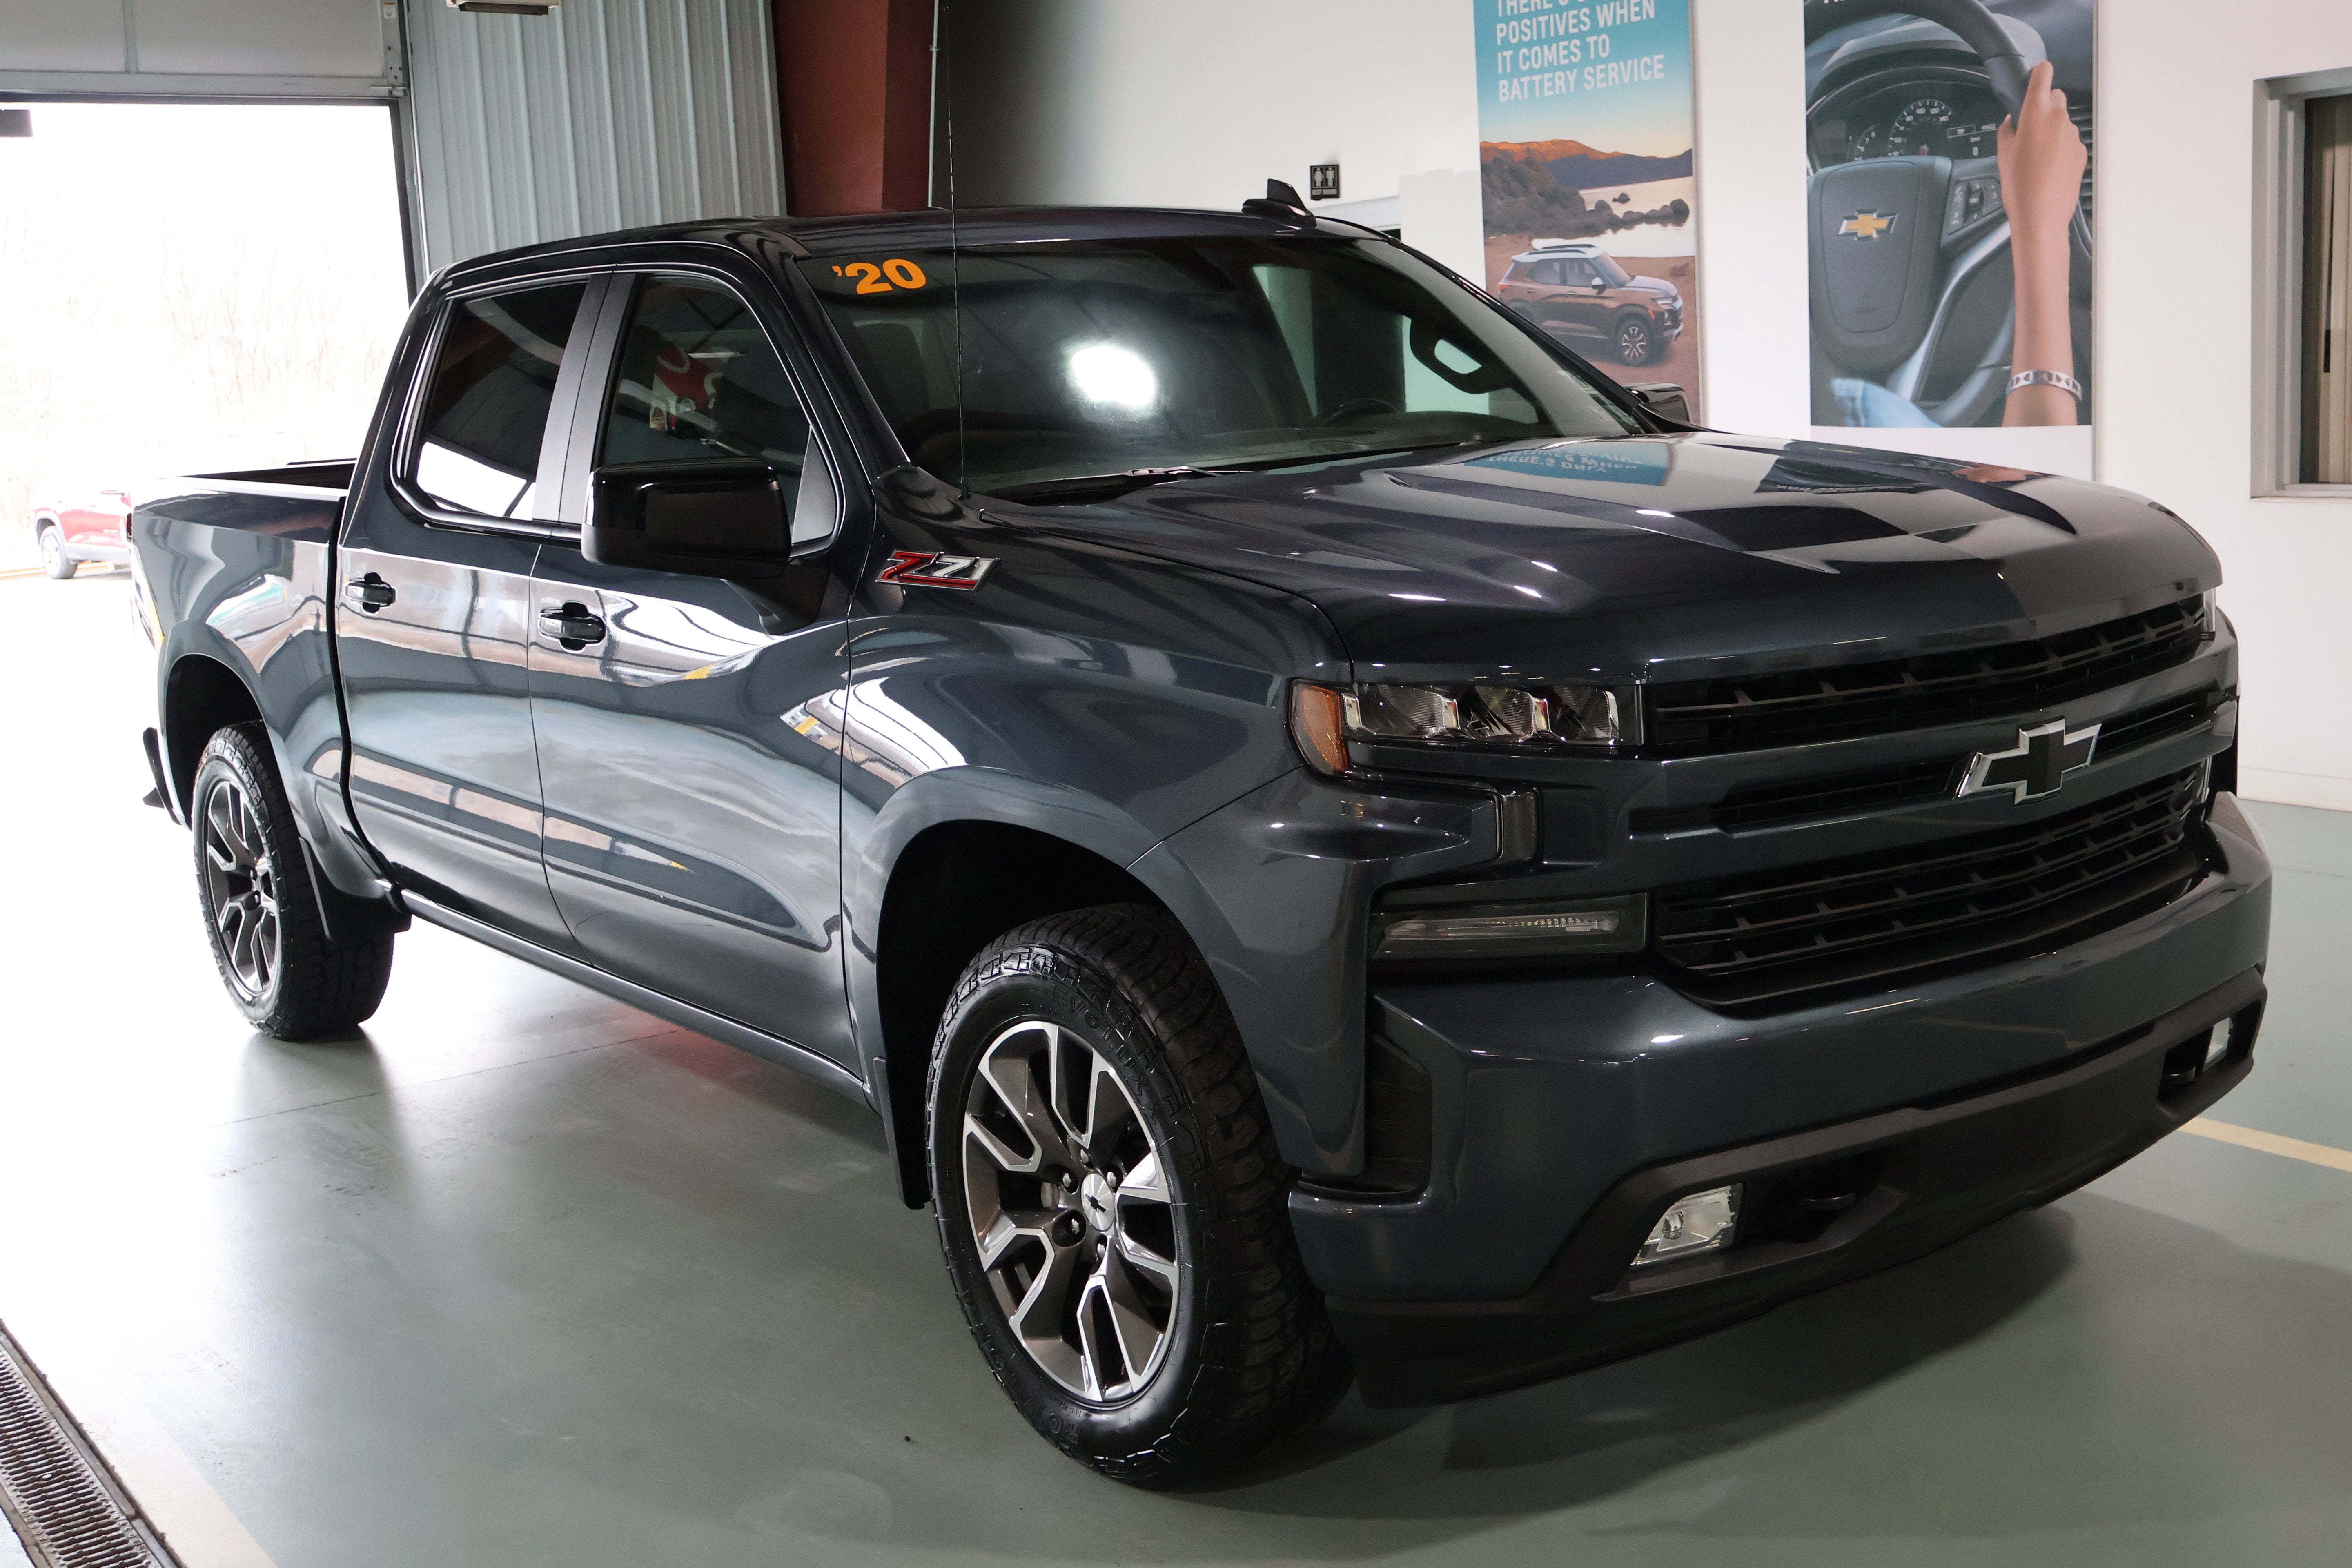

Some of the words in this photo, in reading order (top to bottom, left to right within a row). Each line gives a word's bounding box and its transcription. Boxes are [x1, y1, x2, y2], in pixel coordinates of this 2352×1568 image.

[1496, 8, 1591, 46] POSITIVES
[1596, 0, 1655, 28] WHEN
[1497, 50, 1513, 74] IT
[1518, 39, 1581, 70] COMES
[1586, 34, 1610, 59] TO
[1498, 69, 1578, 102] BATTERY
[1583, 54, 1665, 90] SERVICE
[875, 549, 1002, 592] Z71
